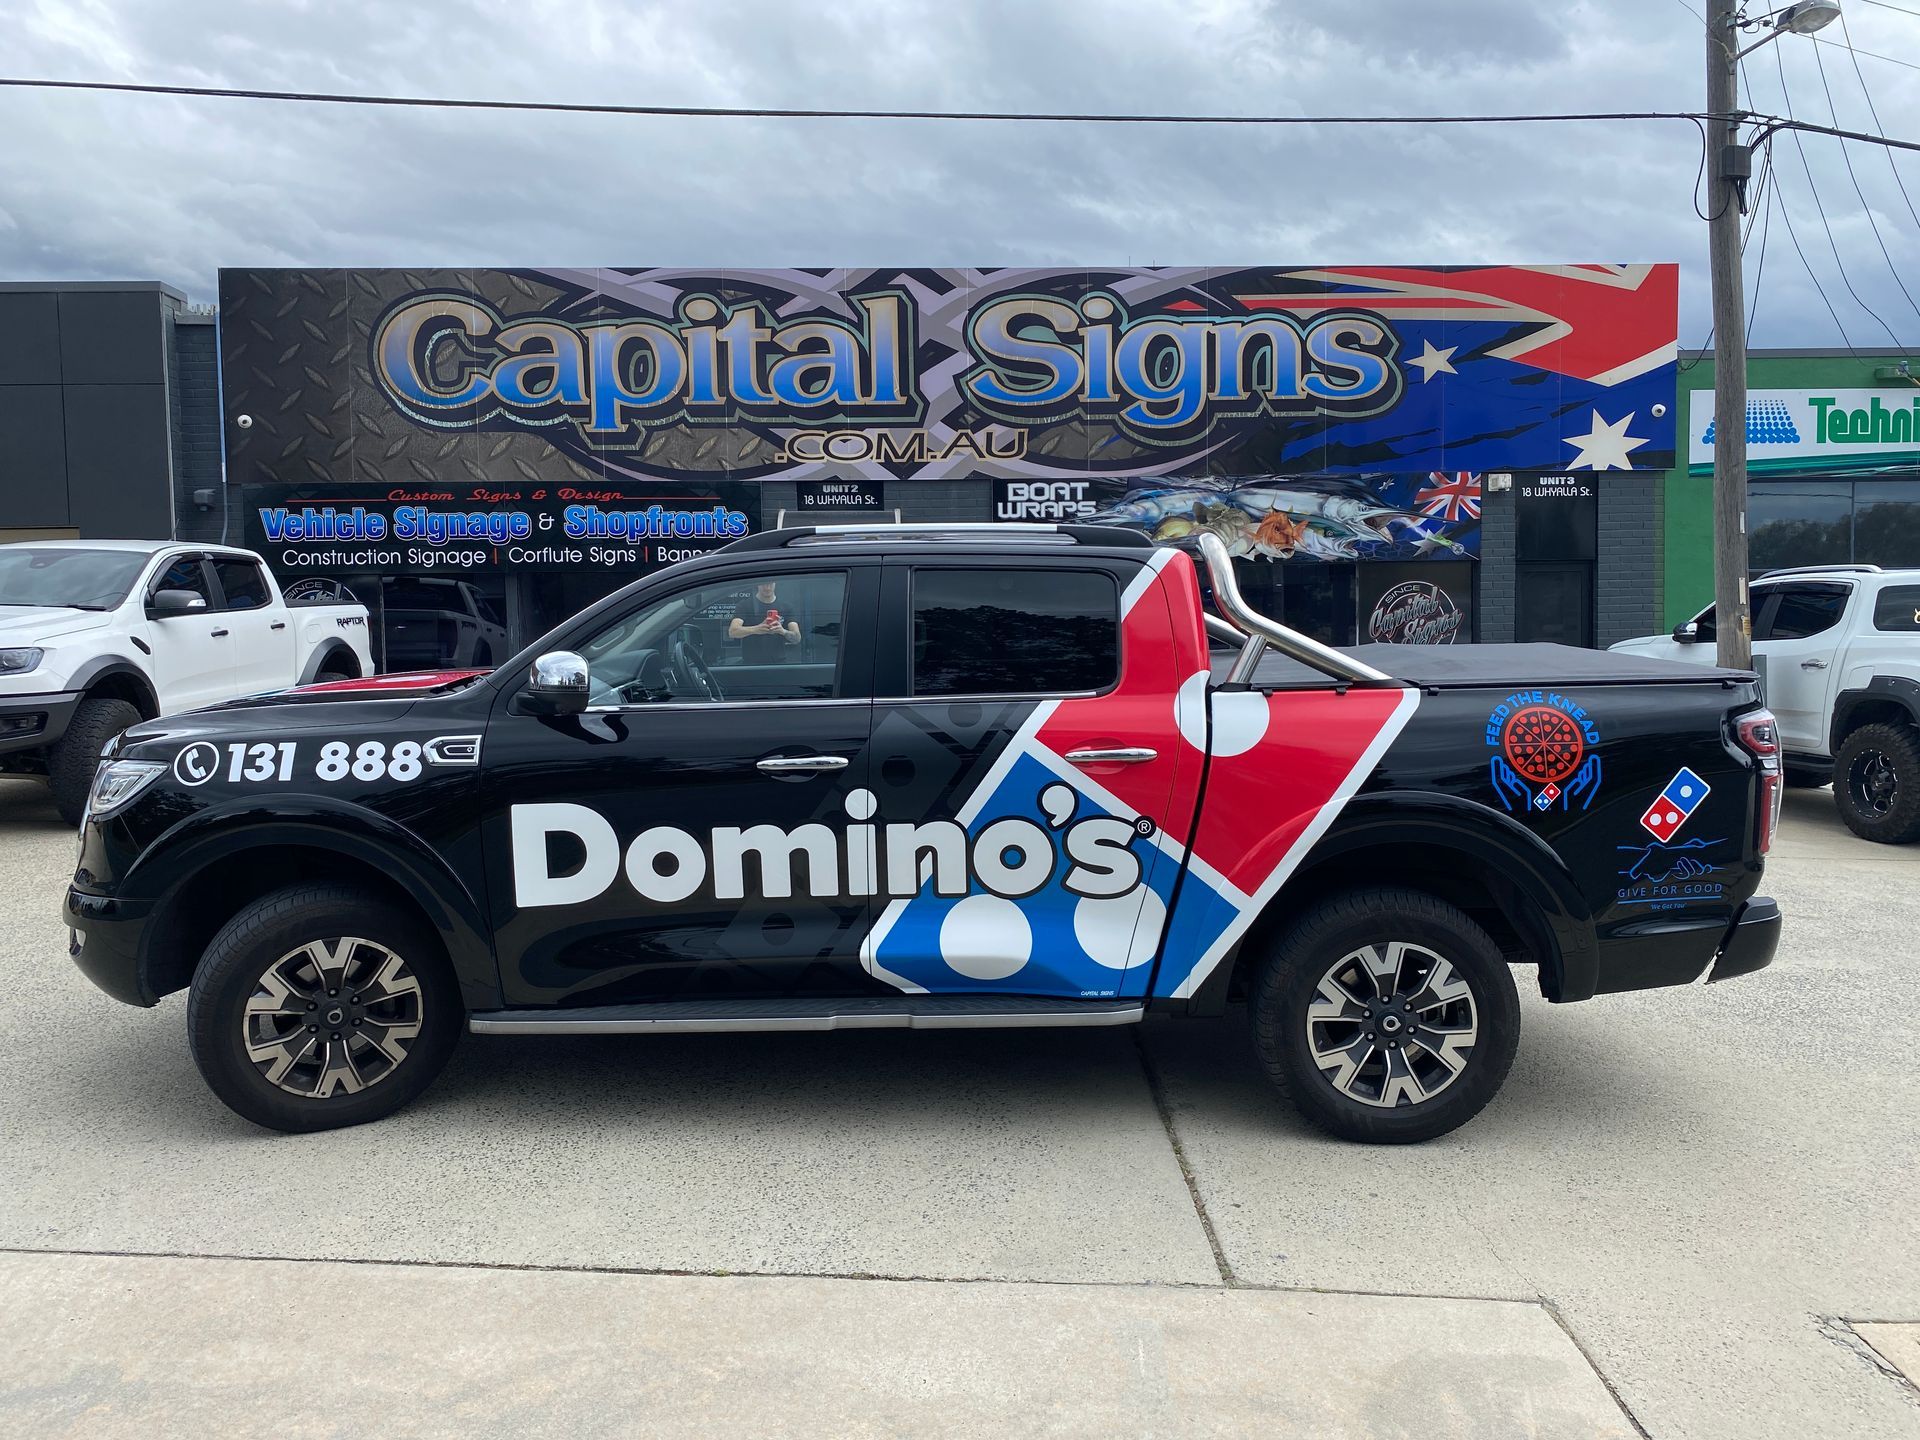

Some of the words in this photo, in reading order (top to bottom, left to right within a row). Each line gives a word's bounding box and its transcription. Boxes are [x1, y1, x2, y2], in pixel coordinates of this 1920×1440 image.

[378, 296, 907, 432] Capital
[967, 296, 1390, 429] Signs
[1808, 396, 1920, 443] Techni
[775, 428, 1029, 463] .COM.AU
[387, 488, 456, 501] Custom
[466, 487, 522, 502] Signs
[531, 489, 547, 500] &
[557, 487, 624, 502] Design
[804, 494, 814, 505] 18
[817, 494, 862, 505] WHYALLA
[864, 494, 878, 505] St.
[1007, 482, 1090, 501] BOAT
[1521, 487, 1532, 497] 18
[1534, 486, 1578, 497] WHYALLA
[1580, 486, 1593, 497] St.
[997, 501, 1097, 519] WRAPS
[259, 506, 388, 542] Vehicle
[393, 506, 532, 546] Signage
[538, 512, 555, 530] &
[563, 504, 749, 545] Shopfronts
[282, 549, 401, 566] Construction
[408, 547, 487, 568] Signage
[508, 546, 583, 563] Corflute
[589, 546, 636, 566] Signs
[285, 581, 323, 600] SINCE
[1384, 584, 1421, 604] SINCE
[1369, 586, 1440, 639] Capital
[336, 616, 367, 630] RAPTOR
[1486, 704, 1510, 746] FEED
[1506, 691, 1544, 708] THE
[1548, 692, 1600, 745] KNEAD
[228, 741, 297, 782] 131
[315, 741, 423, 782] 888
[1617, 887, 1647, 898] GIVE
[1652, 885, 1677, 896] FOR
[1684, 883, 1722, 894] GOOD
